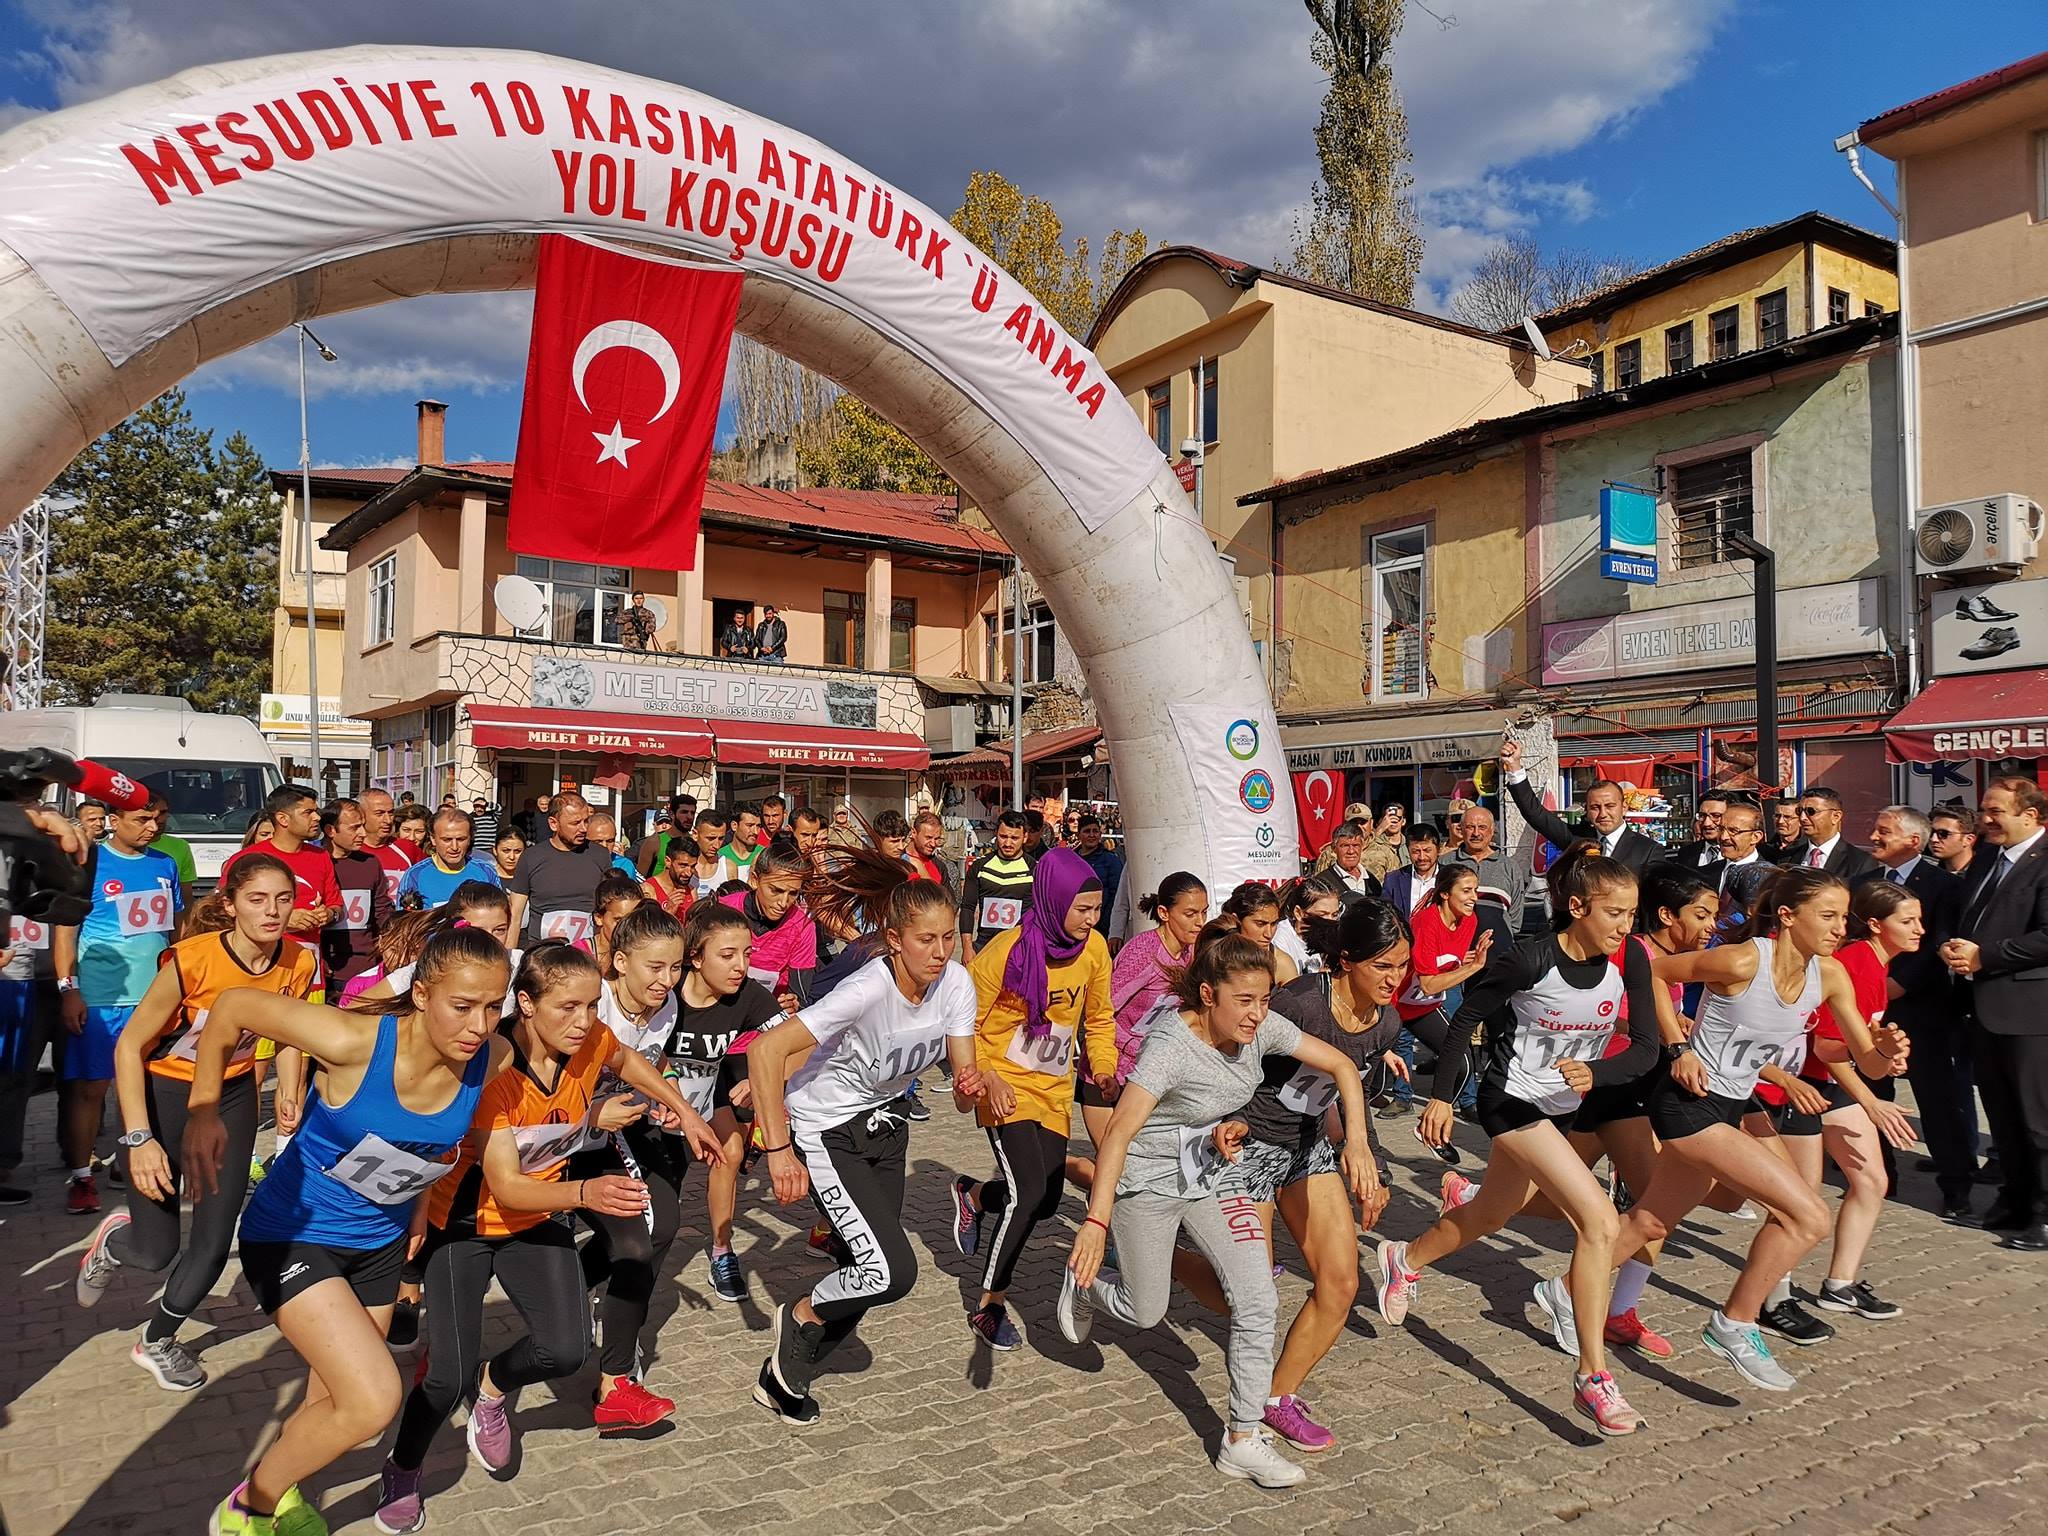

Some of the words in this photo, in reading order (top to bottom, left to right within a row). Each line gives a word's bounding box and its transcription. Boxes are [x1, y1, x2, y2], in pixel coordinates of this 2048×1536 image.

[552, 149, 647, 221] YOL
[665, 166, 853, 283] KOŞUSU
[119, 77, 457, 206] MESUDİYE
[471, 80, 545, 138] 10
[562, 85, 737, 174] KASIM
[758, 138, 951, 280] ATATÜRK
[1003, 302, 1107, 420] ANMA
[1985, 500, 1997, 545] arçelik
[1611, 561, 1633, 574] EVREN
[1632, 563, 1655, 578] TEKEL
[1621, 628, 1670, 661] EVREN
[1674, 622, 1726, 655] TEKEL
[604, 671, 717, 704] MELET
[727, 677, 819, 712] PİZZA
[643, 700, 669, 710] 0542
[671, 702, 690, 712] 414
[692, 703, 704, 714] 32
[706, 704, 719, 715] 43
[726, 706, 749, 717] 0553
[750, 707, 768, 718] 586
[769, 709, 782, 719] 36
[783, 710, 796, 720] 29
[528, 731, 579, 744] MELET
[587, 732, 632, 747] PİZZA
[1932, 727, 2048, 755] GENÇLE
[768, 748, 811, 759] MELET
[818, 748, 855, 761] PİZZA
[1290, 752, 1320, 768] HASAN
[1333, 749, 1355, 764] USTA
[1365, 746, 1413, 763] KUNDURA
[1247, 849, 1282, 858] MESUDİYE
[128, 895, 168, 928] 69
[986, 902, 1017, 925] 63
[548, 915, 588, 942] 47
[1538, 1017, 1611, 1032] TÜRKİYE
[885, 1033, 944, 1082] 107
[1218, 1196, 1266, 1244] HIGH
